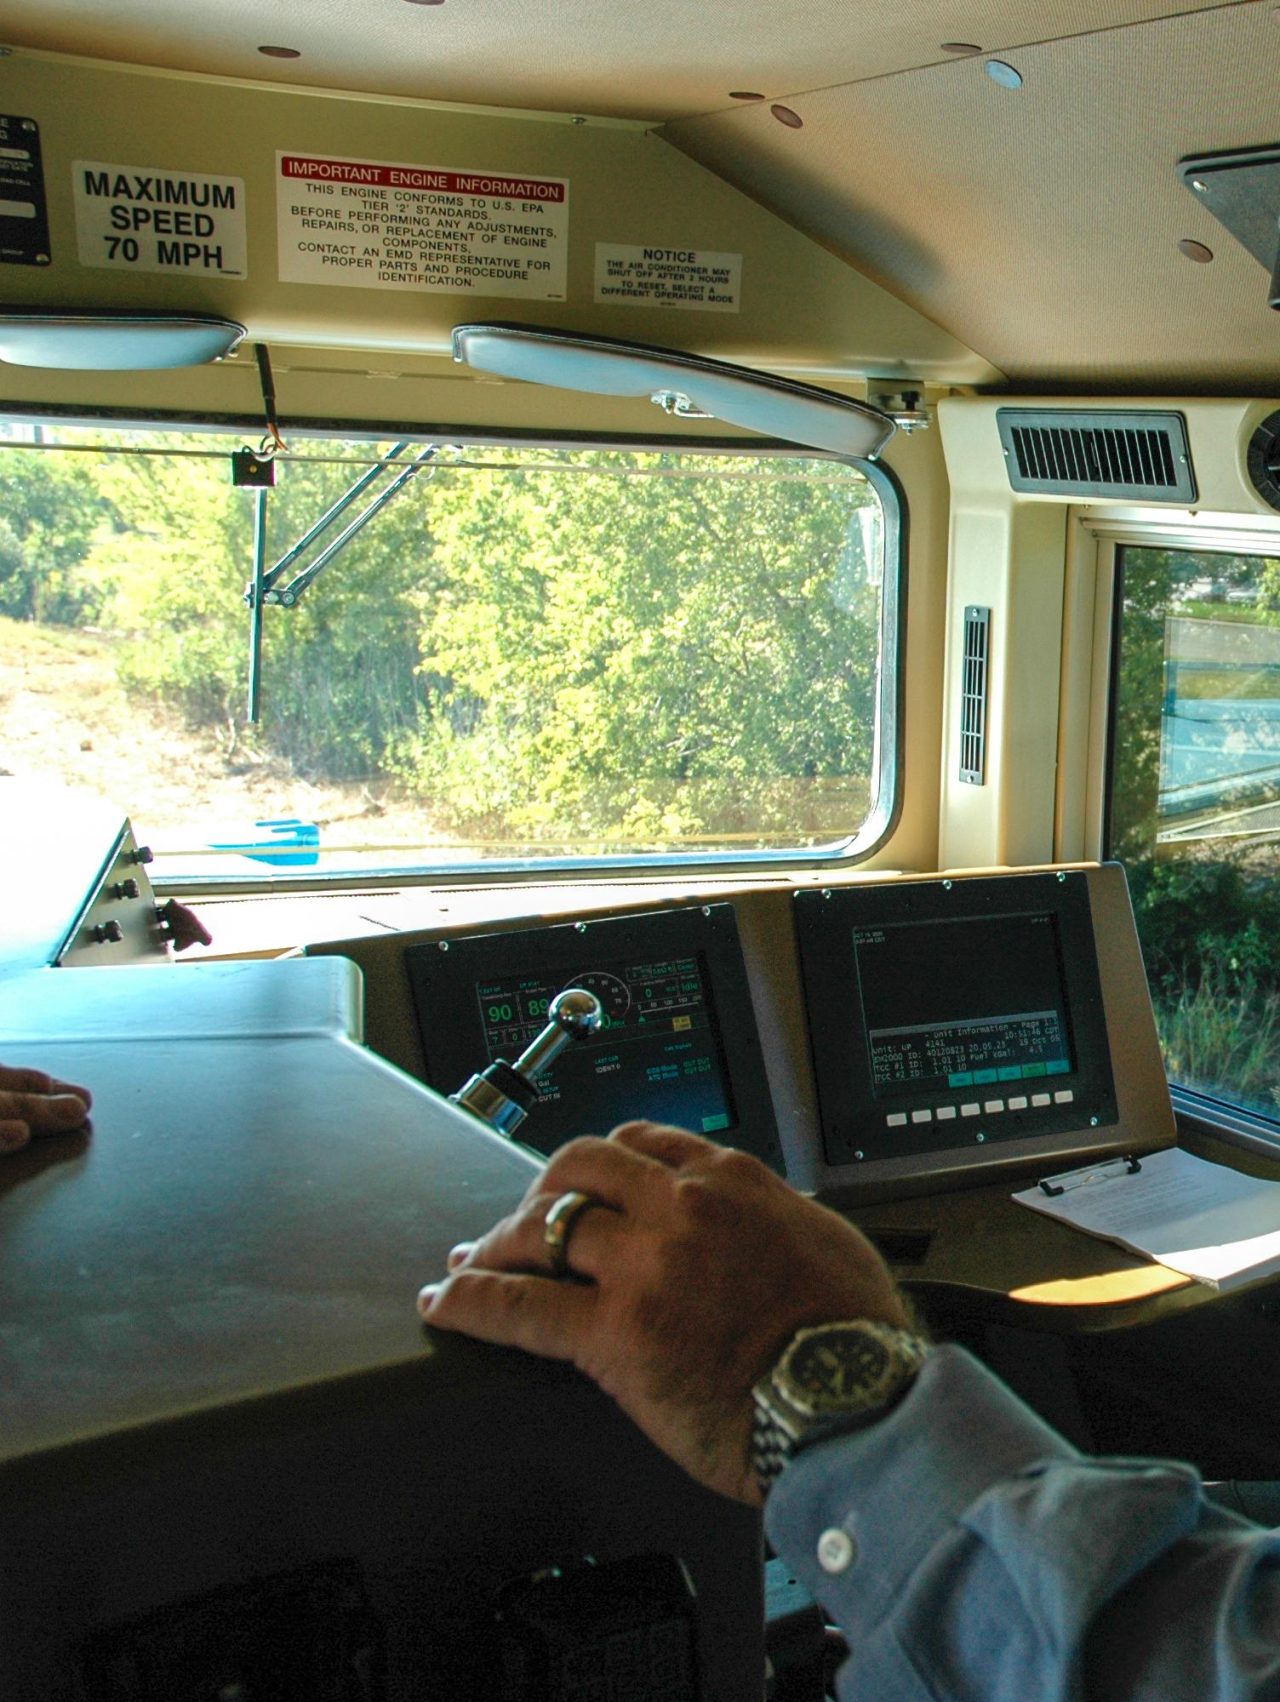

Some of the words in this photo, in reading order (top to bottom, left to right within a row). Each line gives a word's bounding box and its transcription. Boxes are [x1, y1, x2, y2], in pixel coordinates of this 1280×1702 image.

[84, 170, 236, 210] MAXIMUM
[288, 161, 382, 182] IMPORTANT
[390, 171, 448, 188] ENGINE
[456, 177, 560, 199] INFORMATION
[305, 183, 334, 195] THIS
[341, 186, 388, 200] ENGINE
[394, 191, 464, 207] CONFORMS
[471, 199, 486, 209] TO
[493, 201, 516, 212] U.S.
[522, 203, 544, 213] EPA
[361, 199, 389, 212] TIER
[416, 205, 492, 221] STANDARDS.
[110, 205, 215, 237] SPEED
[291, 205, 342, 219] BEFORE
[348, 210, 430, 227] PERFORMING
[437, 219, 460, 229] ANY
[467, 222, 557, 239] ADJUSTMENTS,
[302, 218, 359, 234] REPAIRS,
[361, 224, 380, 234] OR
[386, 225, 476, 242] REPLACEMENT
[481, 233, 498, 244] OF
[503, 236, 548, 248] ENGINE
[104, 236, 139, 262] 70
[157, 241, 222, 269] MPH
[297, 241, 356, 256] CONTACT
[363, 247, 380, 257] AN
[386, 249, 413, 260] EMD
[419, 251, 521, 269] REPRESENTATIVE
[527, 259, 551, 271] FOR
[643, 248, 697, 264] NOTICE
[322, 255, 373, 268] PROPER
[379, 260, 418, 272] PARTS
[424, 263, 449, 274] AND
[455, 265, 529, 280] PROCEDURE
[378, 271, 476, 288] IDENTIFICATION.
[606, 259, 625, 269] THE
[628, 261, 644, 270] AIR
[647, 263, 709, 275] CONDITIONER
[712, 268, 731, 276] MAY
[607, 268, 632, 277] SHUT
[635, 270, 653, 279] OFF
[657, 271, 685, 281] AFTER
[699, 275, 729, 284] HOURS
[601, 286, 651, 298] DIFFERENT
[654, 290, 705, 301] OPERATING
[708, 294, 734, 304] MODE
[621, 280, 634, 288] TO
[672, 283, 705, 293] SELECT
[488, 1004, 513, 1022] 90
[527, 998, 550, 1016] 89
[958, 1023, 1009, 1036] Information
